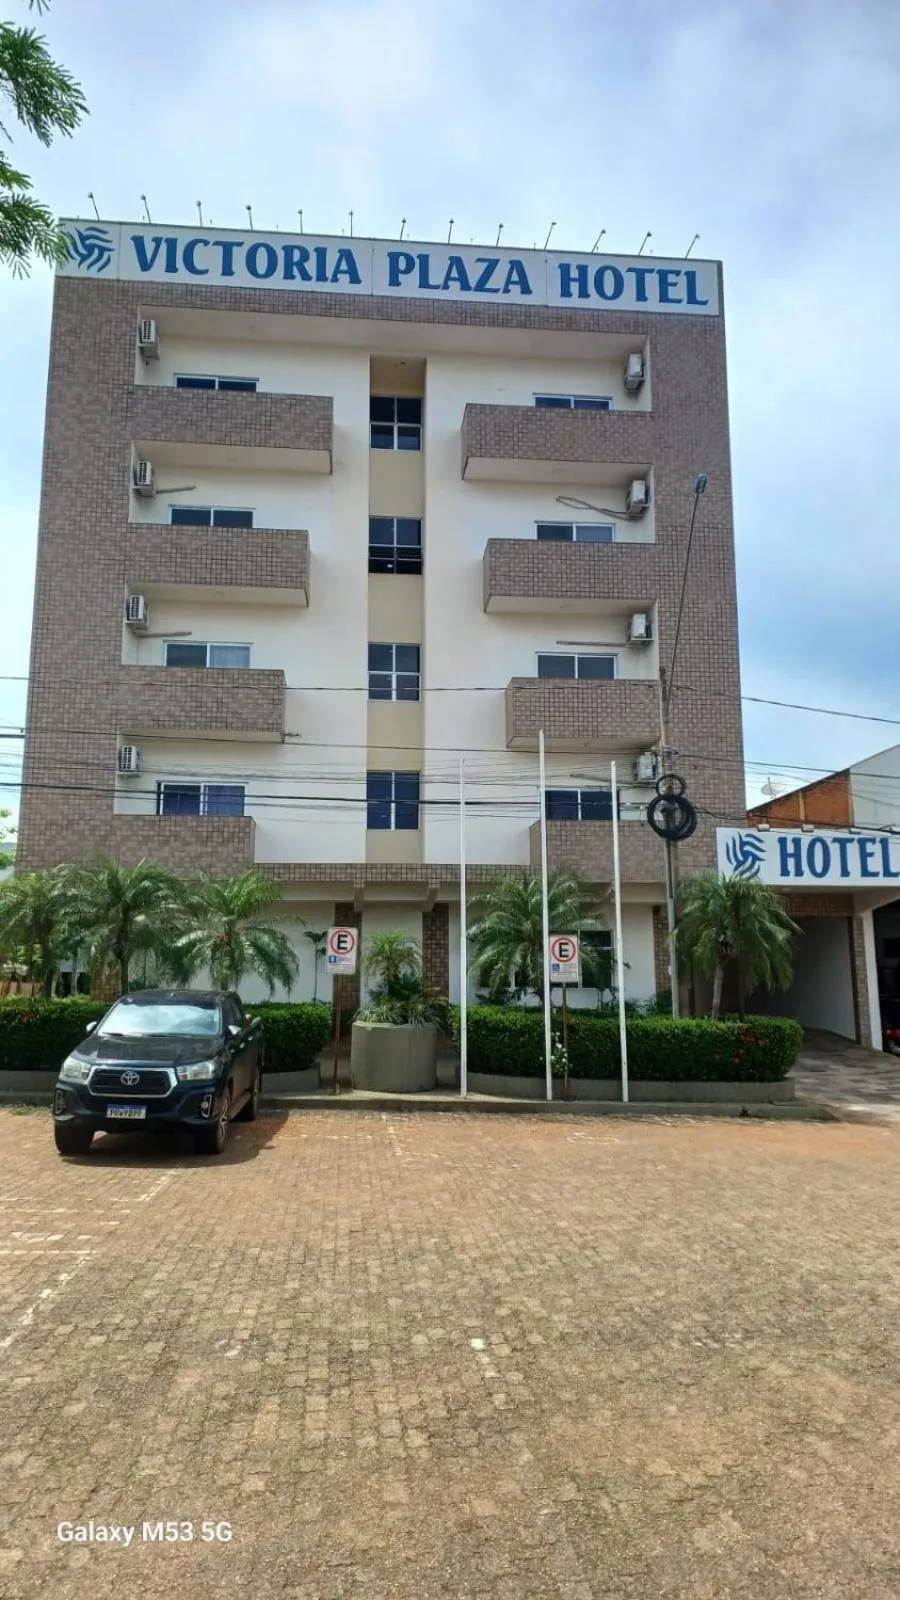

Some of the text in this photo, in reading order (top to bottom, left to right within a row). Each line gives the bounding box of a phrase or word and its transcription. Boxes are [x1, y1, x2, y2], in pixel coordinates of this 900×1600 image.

[131, 234, 709, 306] VICTORIA PLAZA HOTEL
[778, 836, 900, 879] HOTEL
[337, 933, 348, 950] E
[559, 941, 569, 958] E
